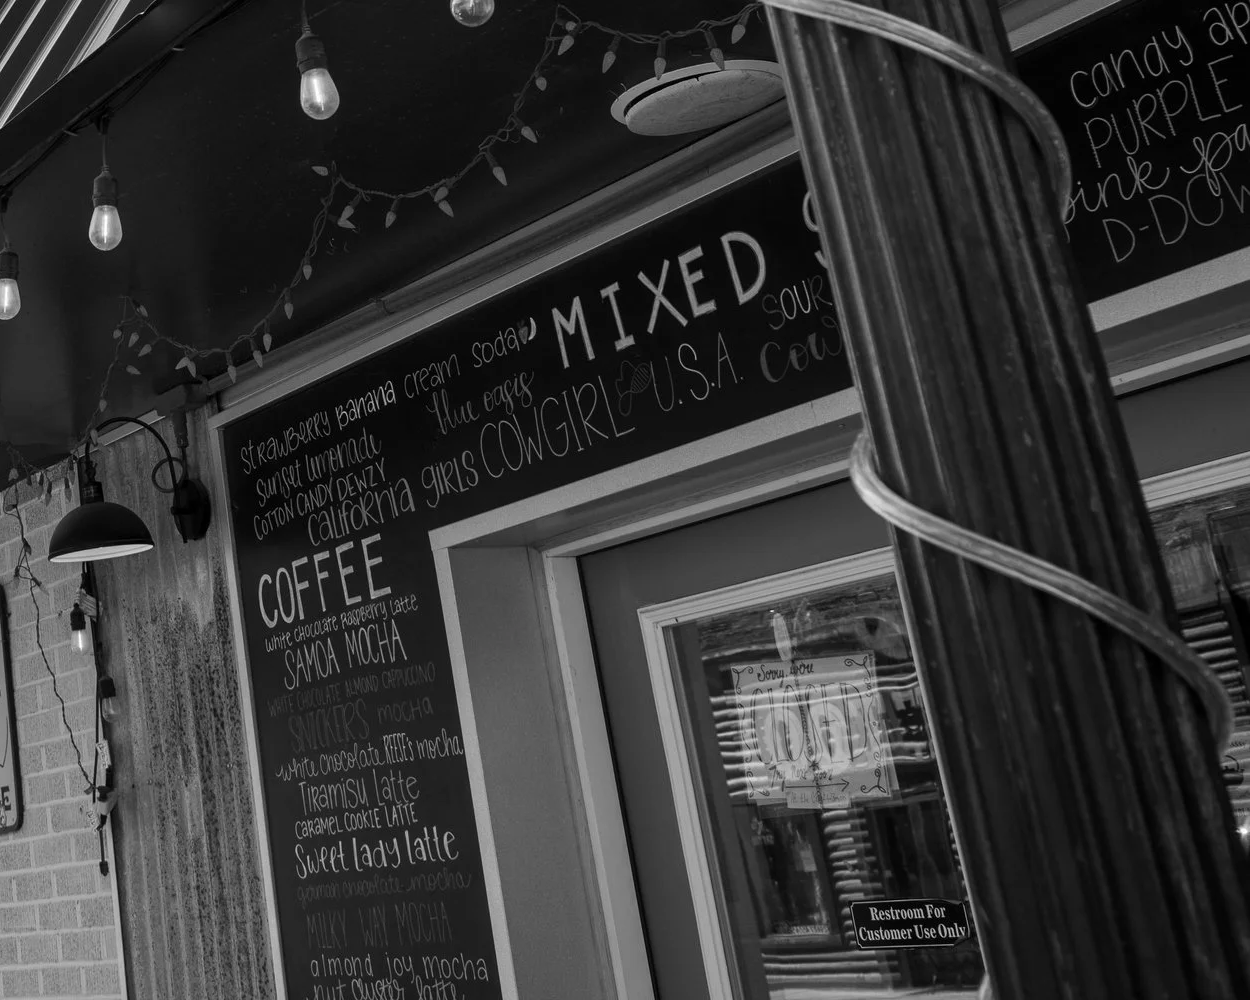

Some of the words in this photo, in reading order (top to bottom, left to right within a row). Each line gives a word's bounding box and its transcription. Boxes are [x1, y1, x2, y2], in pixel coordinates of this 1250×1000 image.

[1070, 25, 1194, 108] candy
[1084, 54, 1244, 168] PURPLE
[551, 230, 767, 370] MIXED
[484, 371, 535, 414] oasis
[650, 332, 745, 412] U.S.A.
[480, 375, 636, 478] COWGIRL
[296, 476, 334, 516] CANDY
[337, 457, 387, 502] DEWZY
[258, 532, 392, 628] COFFEE
[284, 637, 340, 690] SAMOA
[344, 618, 408, 668] MOCHA
[288, 698, 370, 753] SNICKERS
[417, 728, 464, 761] mocha
[751, 683, 867, 764] CLOSED
[344, 808, 382, 831] COOKIE
[384, 802, 418, 827] LATTE
[859, 926, 913, 941] Customer
[913, 924, 937, 939] Use
[869, 905, 925, 921] Restroom
[925, 904, 946, 918] For
[310, 953, 373, 978] almond
[385, 952, 415, 984] joy
[422, 952, 489, 982] mocha
